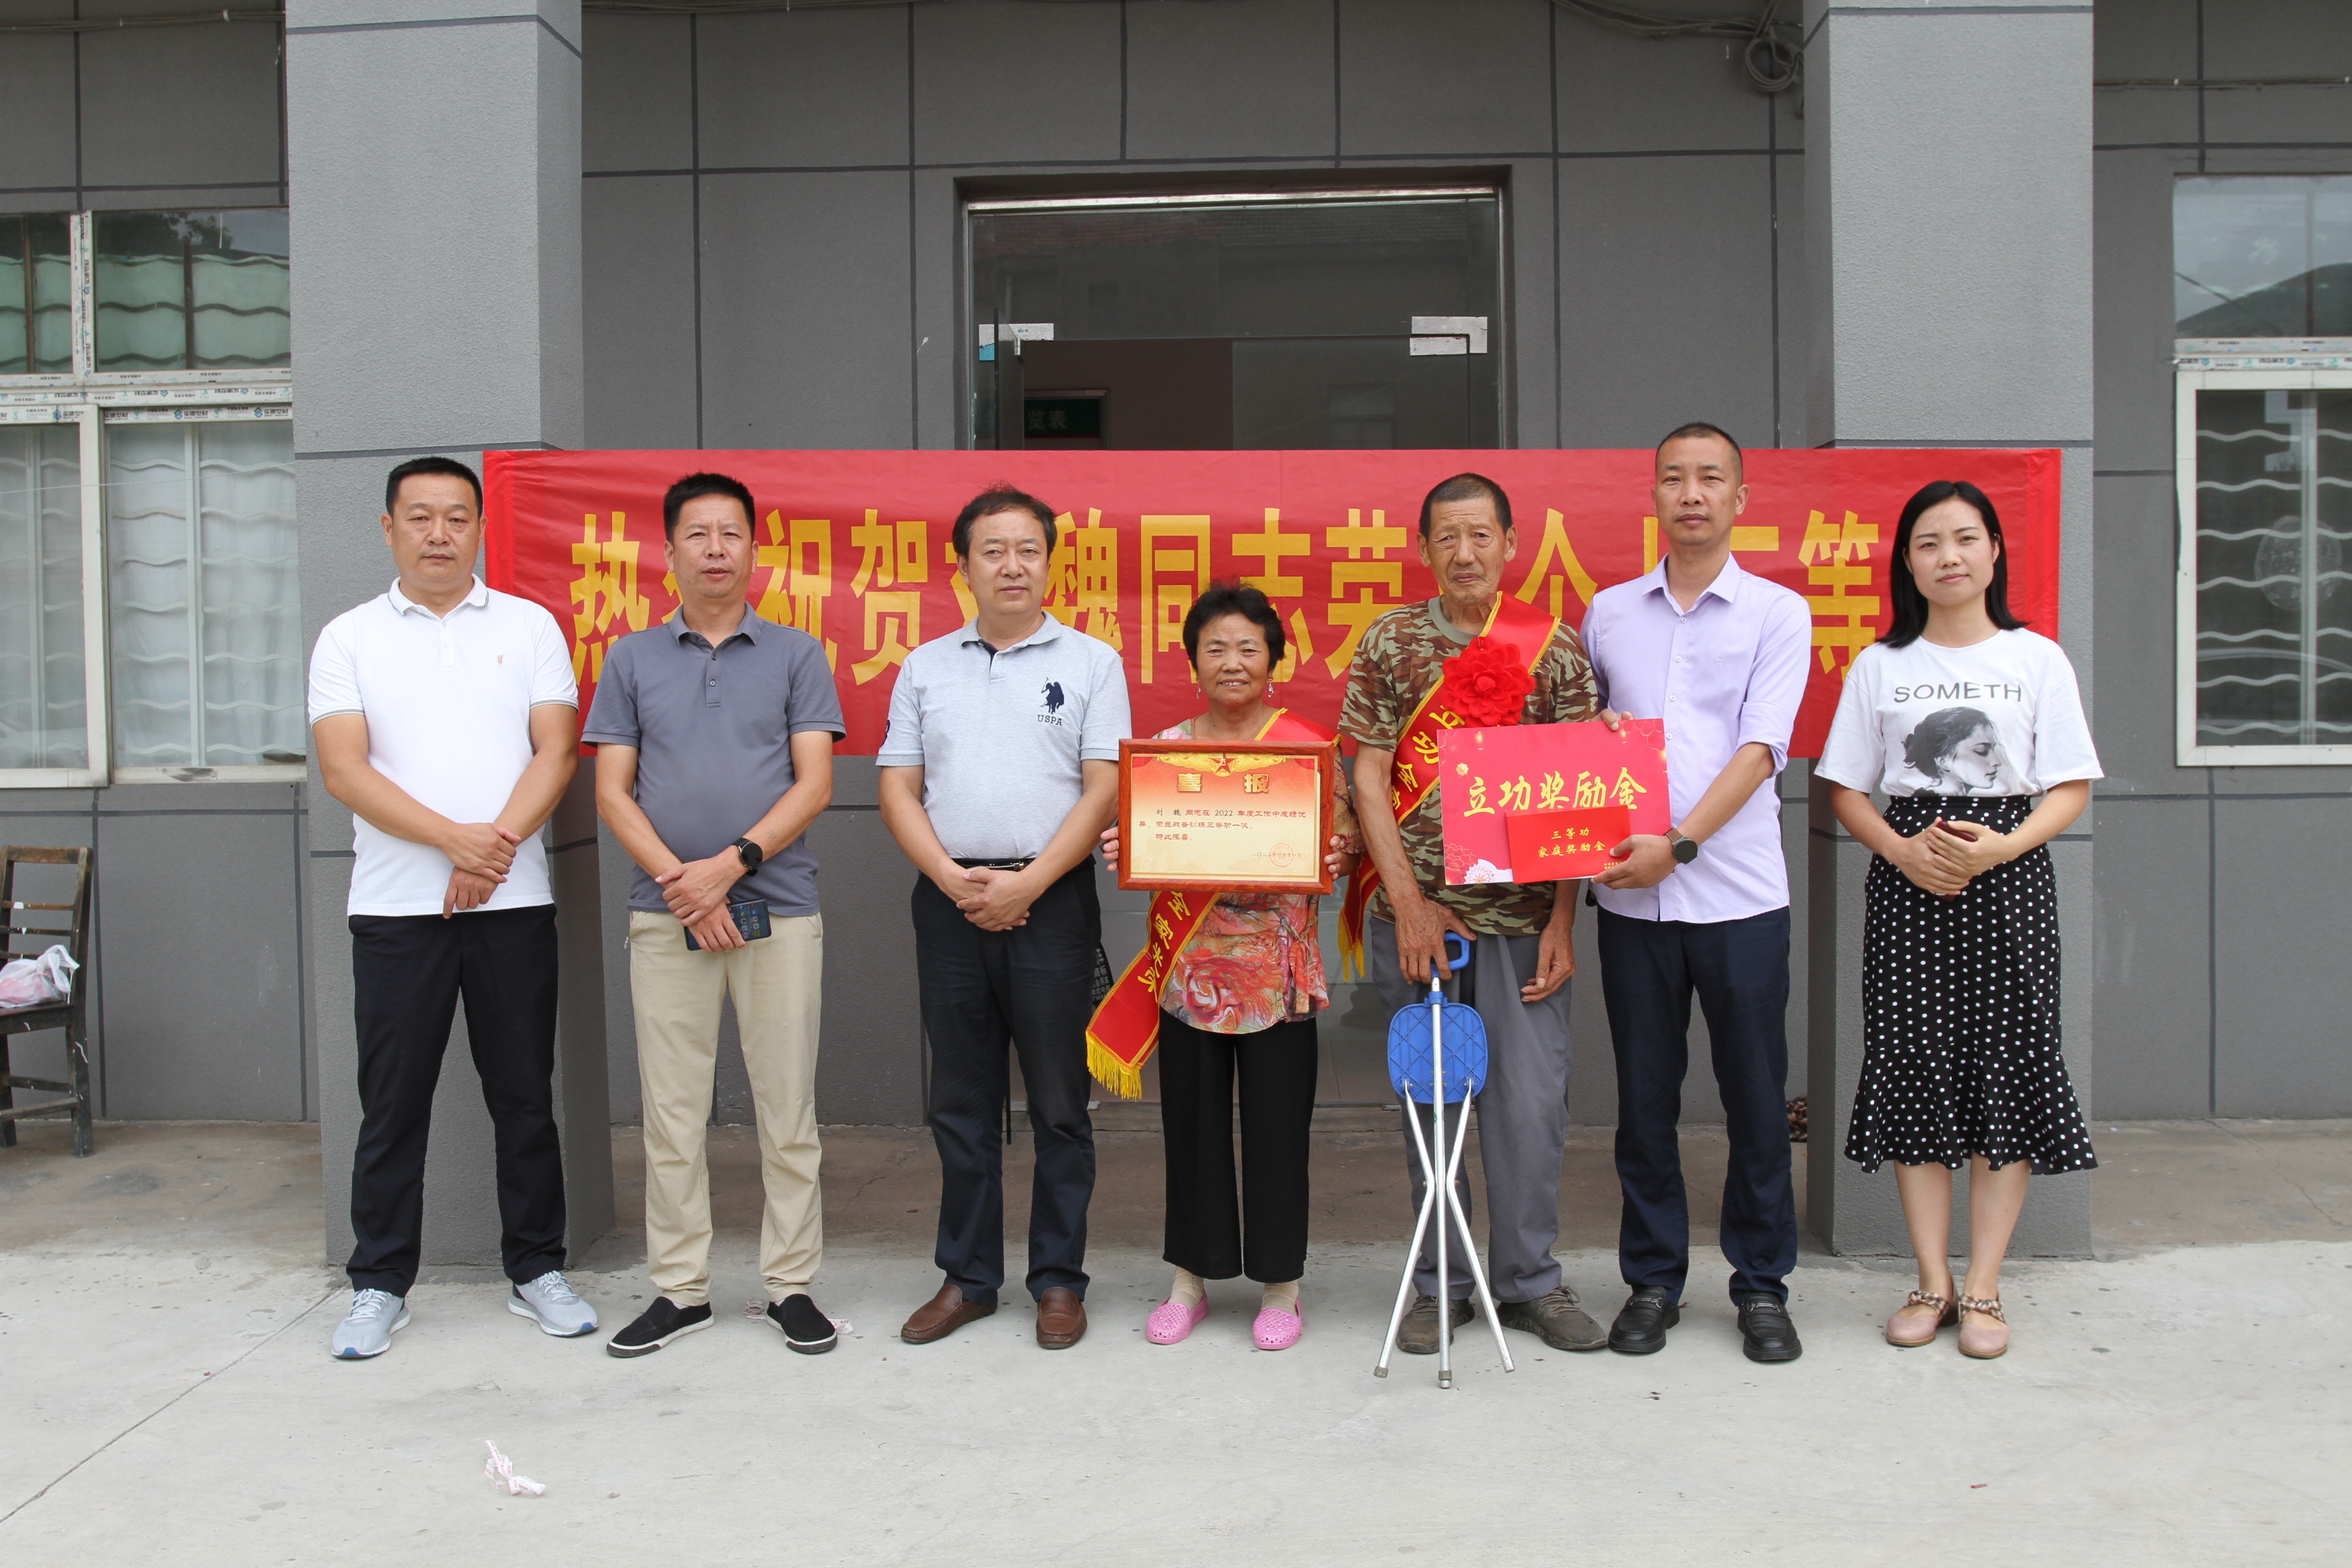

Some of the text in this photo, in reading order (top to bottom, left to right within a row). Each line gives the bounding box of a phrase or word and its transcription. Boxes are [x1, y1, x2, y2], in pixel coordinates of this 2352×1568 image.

[1893, 681, 2021, 703] SOMETH
[1037, 715, 1062, 726] USPA
[1463, 766, 1648, 817] 立功奖励金
[1551, 827, 1590, 840] 三等功
[1537, 840, 1605, 858] 家庭奖励金
